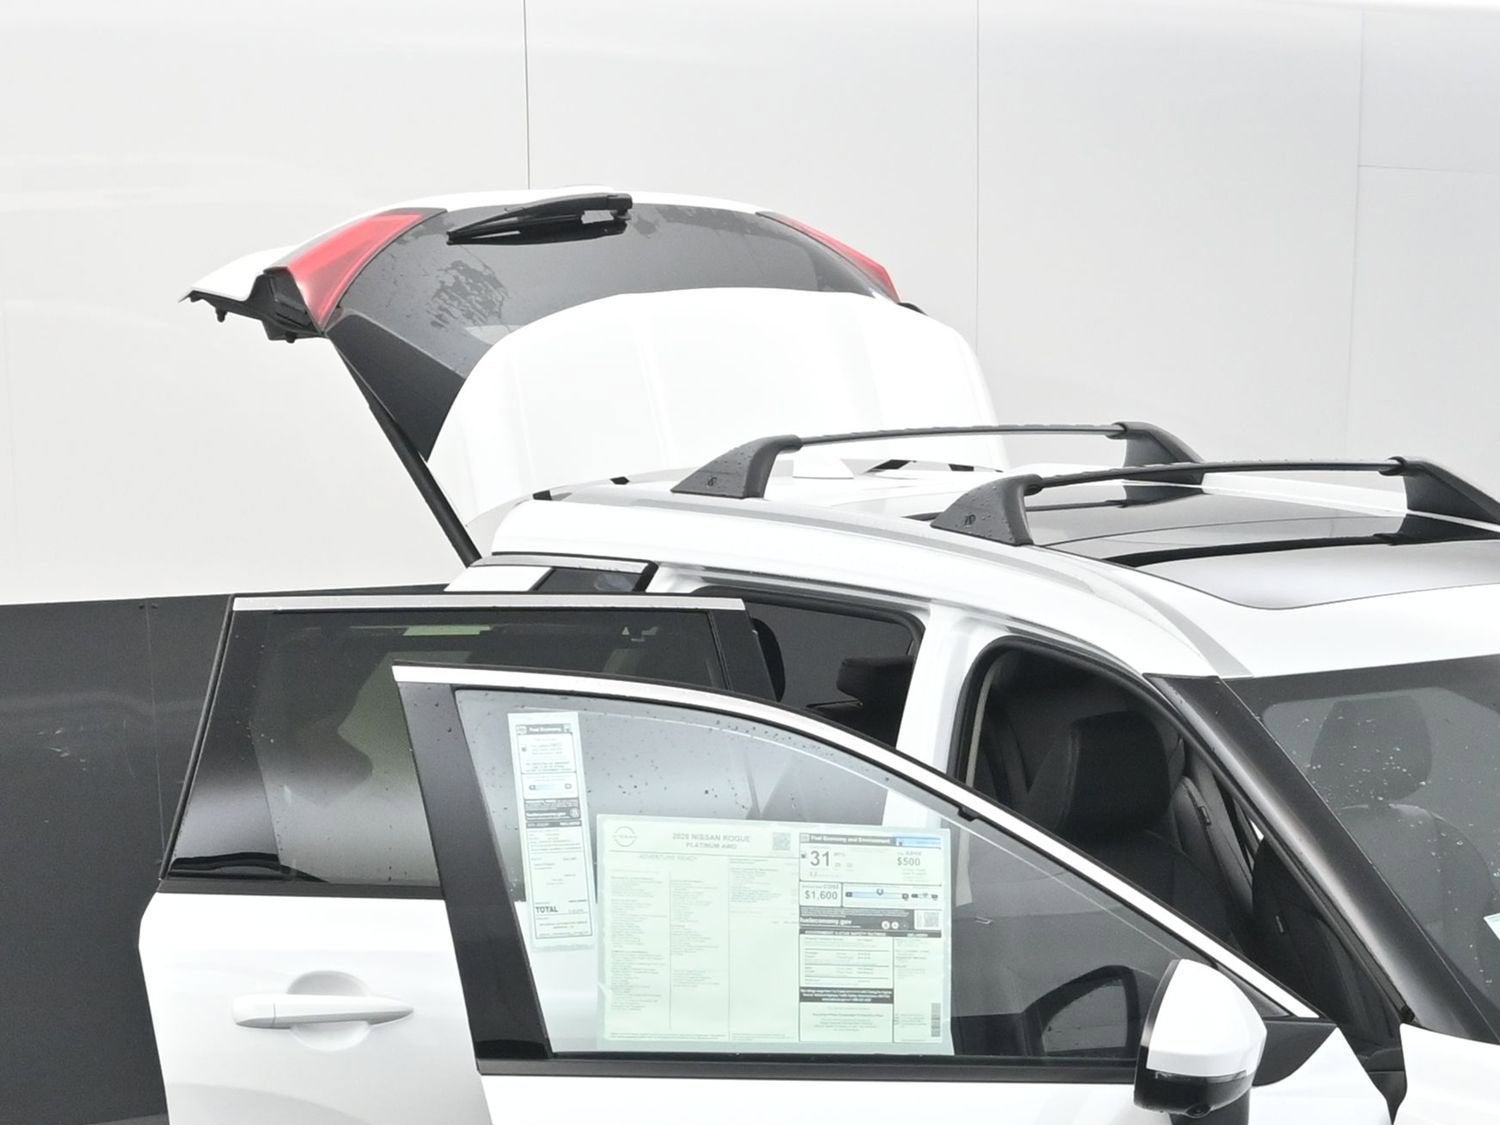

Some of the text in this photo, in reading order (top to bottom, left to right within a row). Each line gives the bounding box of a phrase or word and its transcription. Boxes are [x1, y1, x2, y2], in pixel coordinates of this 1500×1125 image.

[691, 833, 721, 842] NISSAN
[723, 834, 751, 843] ROGUE
[810, 850, 829, 866] 31
[897, 856, 920, 866] $500
[805, 889, 838, 901] $1,600
[535, 905, 558, 913] TOTAL
